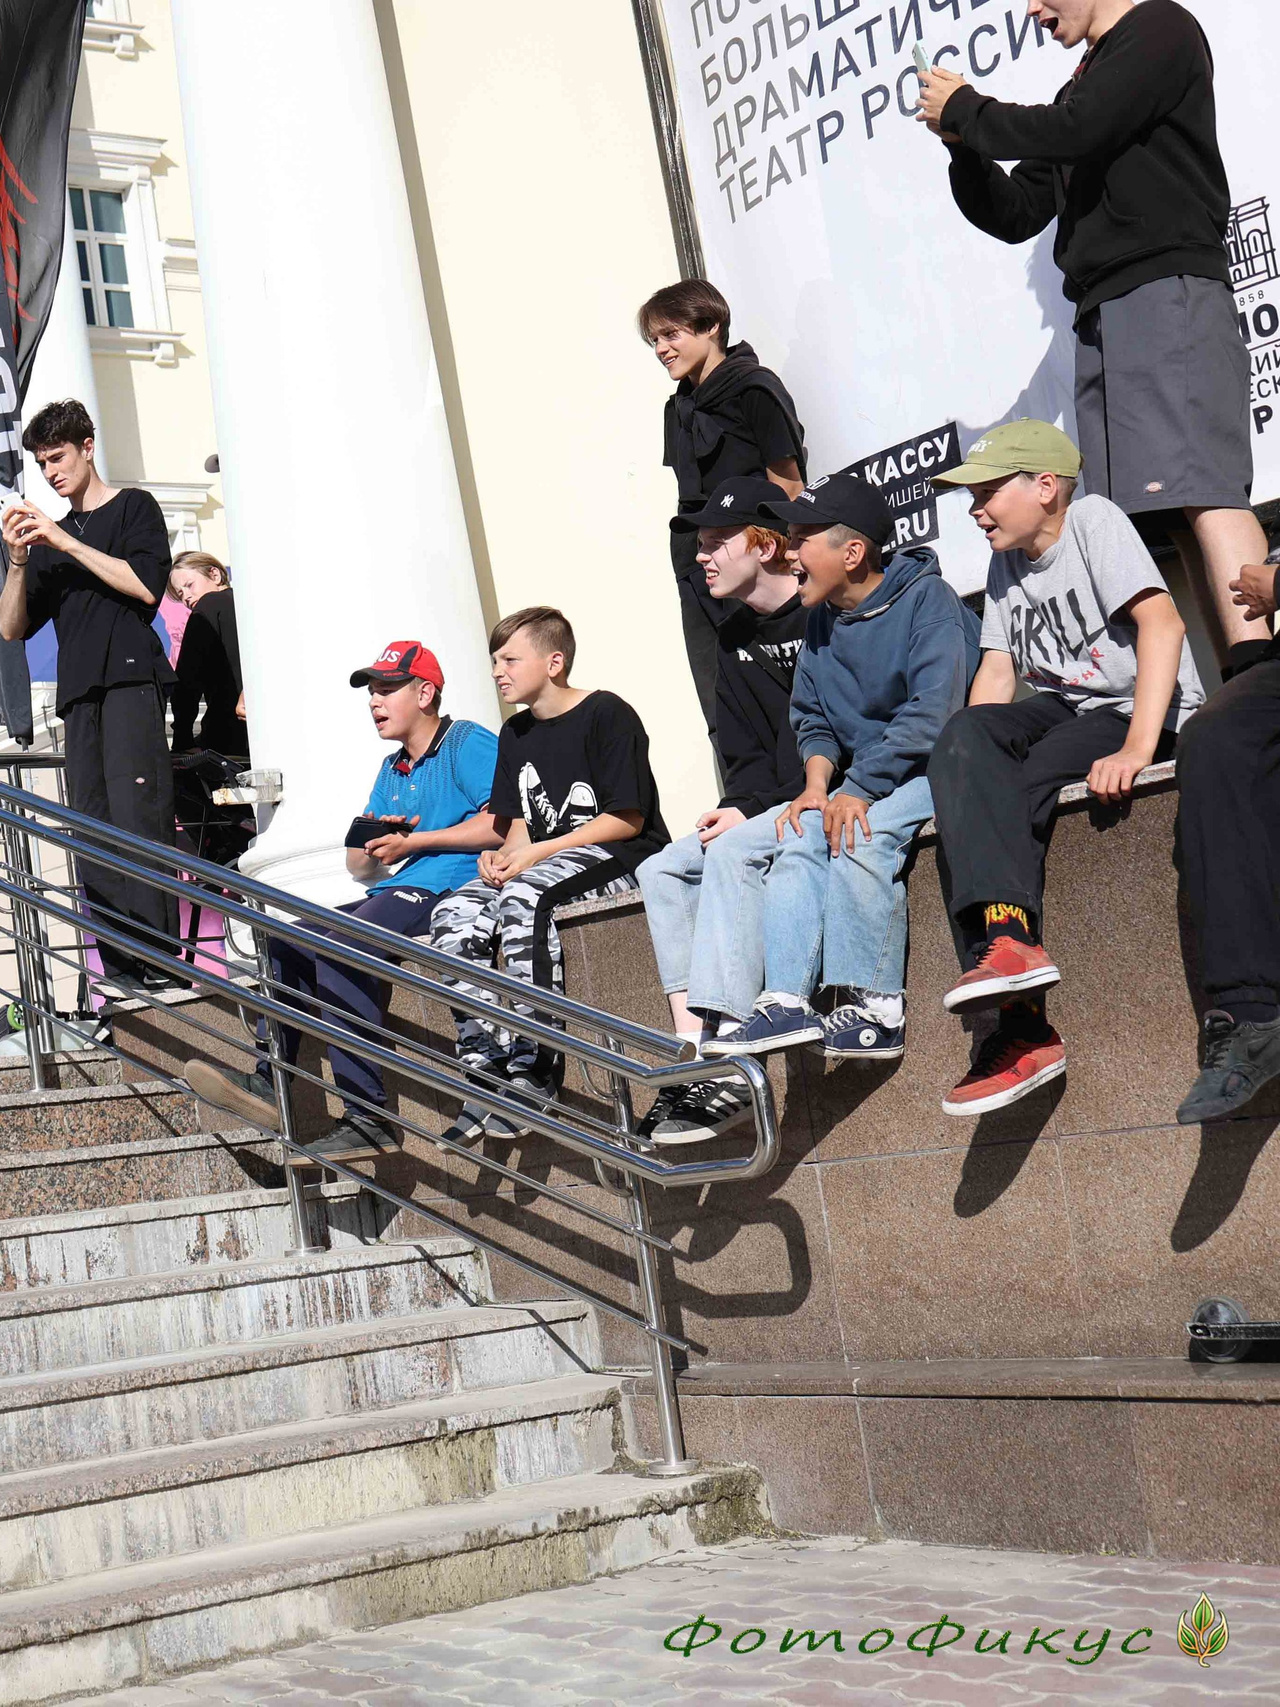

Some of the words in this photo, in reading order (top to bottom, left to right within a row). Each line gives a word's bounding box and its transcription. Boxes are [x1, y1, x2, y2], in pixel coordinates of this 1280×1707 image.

[690, 0, 764, 49] ПО
[713, 0, 990, 178] ДРАМАТИ
[720, 110, 844, 224] ТЕАТР
[864, 432, 950, 488] КАССУ
[881, 508, 931, 554] .RU
